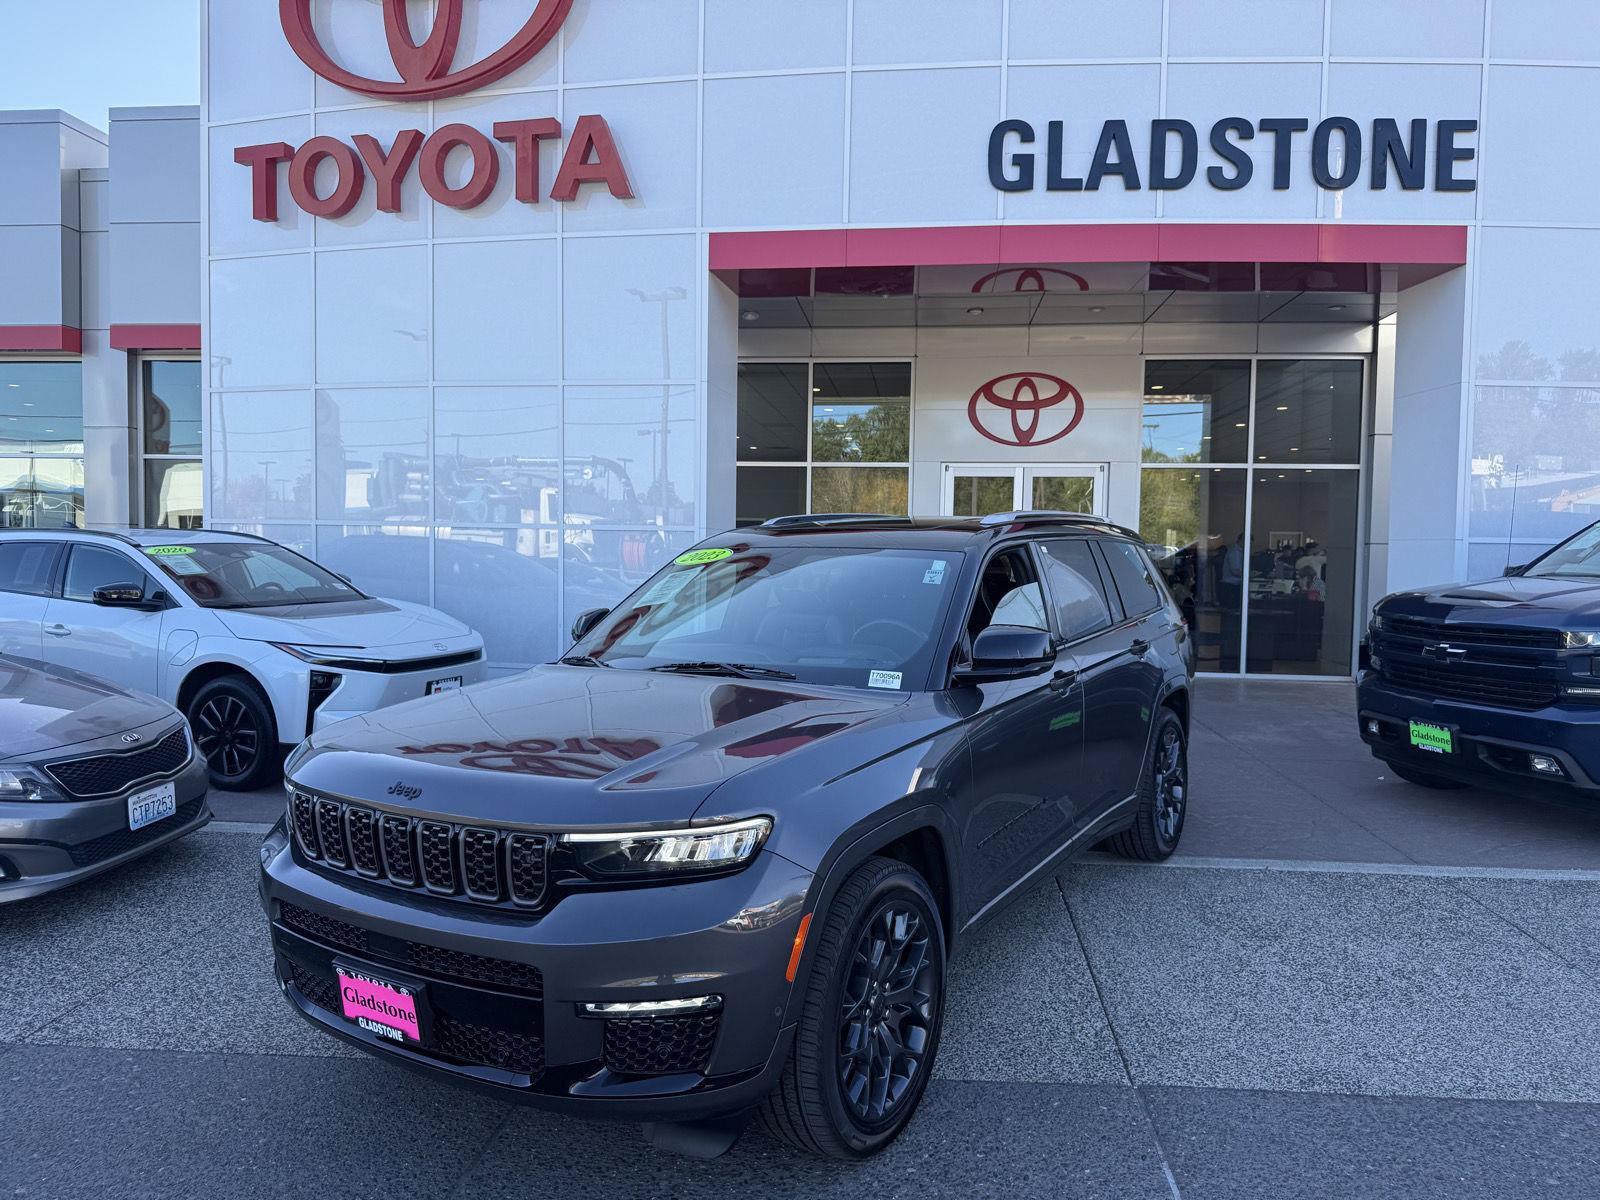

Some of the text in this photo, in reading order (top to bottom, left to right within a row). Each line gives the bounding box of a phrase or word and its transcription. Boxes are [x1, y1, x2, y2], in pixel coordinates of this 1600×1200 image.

[987, 116, 1478, 192] GLADSTONE
[234, 113, 637, 222] TOYOTA
[152, 546, 188, 554] 2026
[1411, 728, 1451, 746] Gladstone
[387, 781, 423, 801] Jeep
[132, 794, 174, 824] CTP7253
[350, 971, 394, 991] TOYOTA
[342, 986, 417, 1024] Gladstone
[358, 1016, 404, 1042] GLADSTONE
